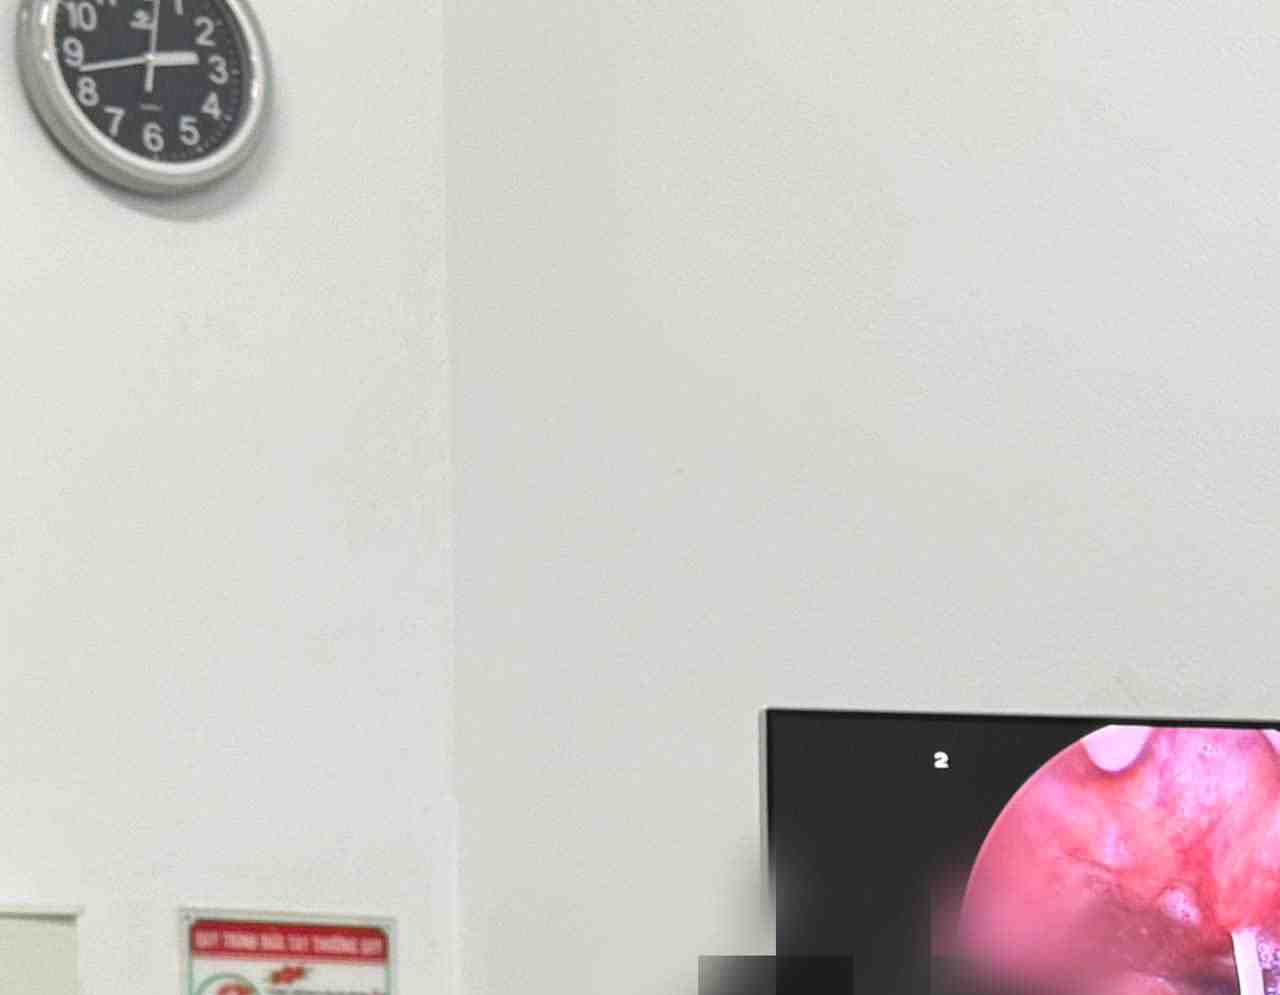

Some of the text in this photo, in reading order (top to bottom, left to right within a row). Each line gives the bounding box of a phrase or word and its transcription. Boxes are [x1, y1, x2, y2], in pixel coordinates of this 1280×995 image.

[67, 1, 97, 31] 10
[195, 16, 217, 47] 2
[62, 37, 84, 67] 9
[208, 55, 229, 85] 3
[77, 77, 99, 107] 8
[202, 92, 222, 120] 4
[104, 106, 125, 137] 7
[178, 116, 201, 146] 5
[142, 122, 165, 152] 6
[933, 750, 950, 769] 2
